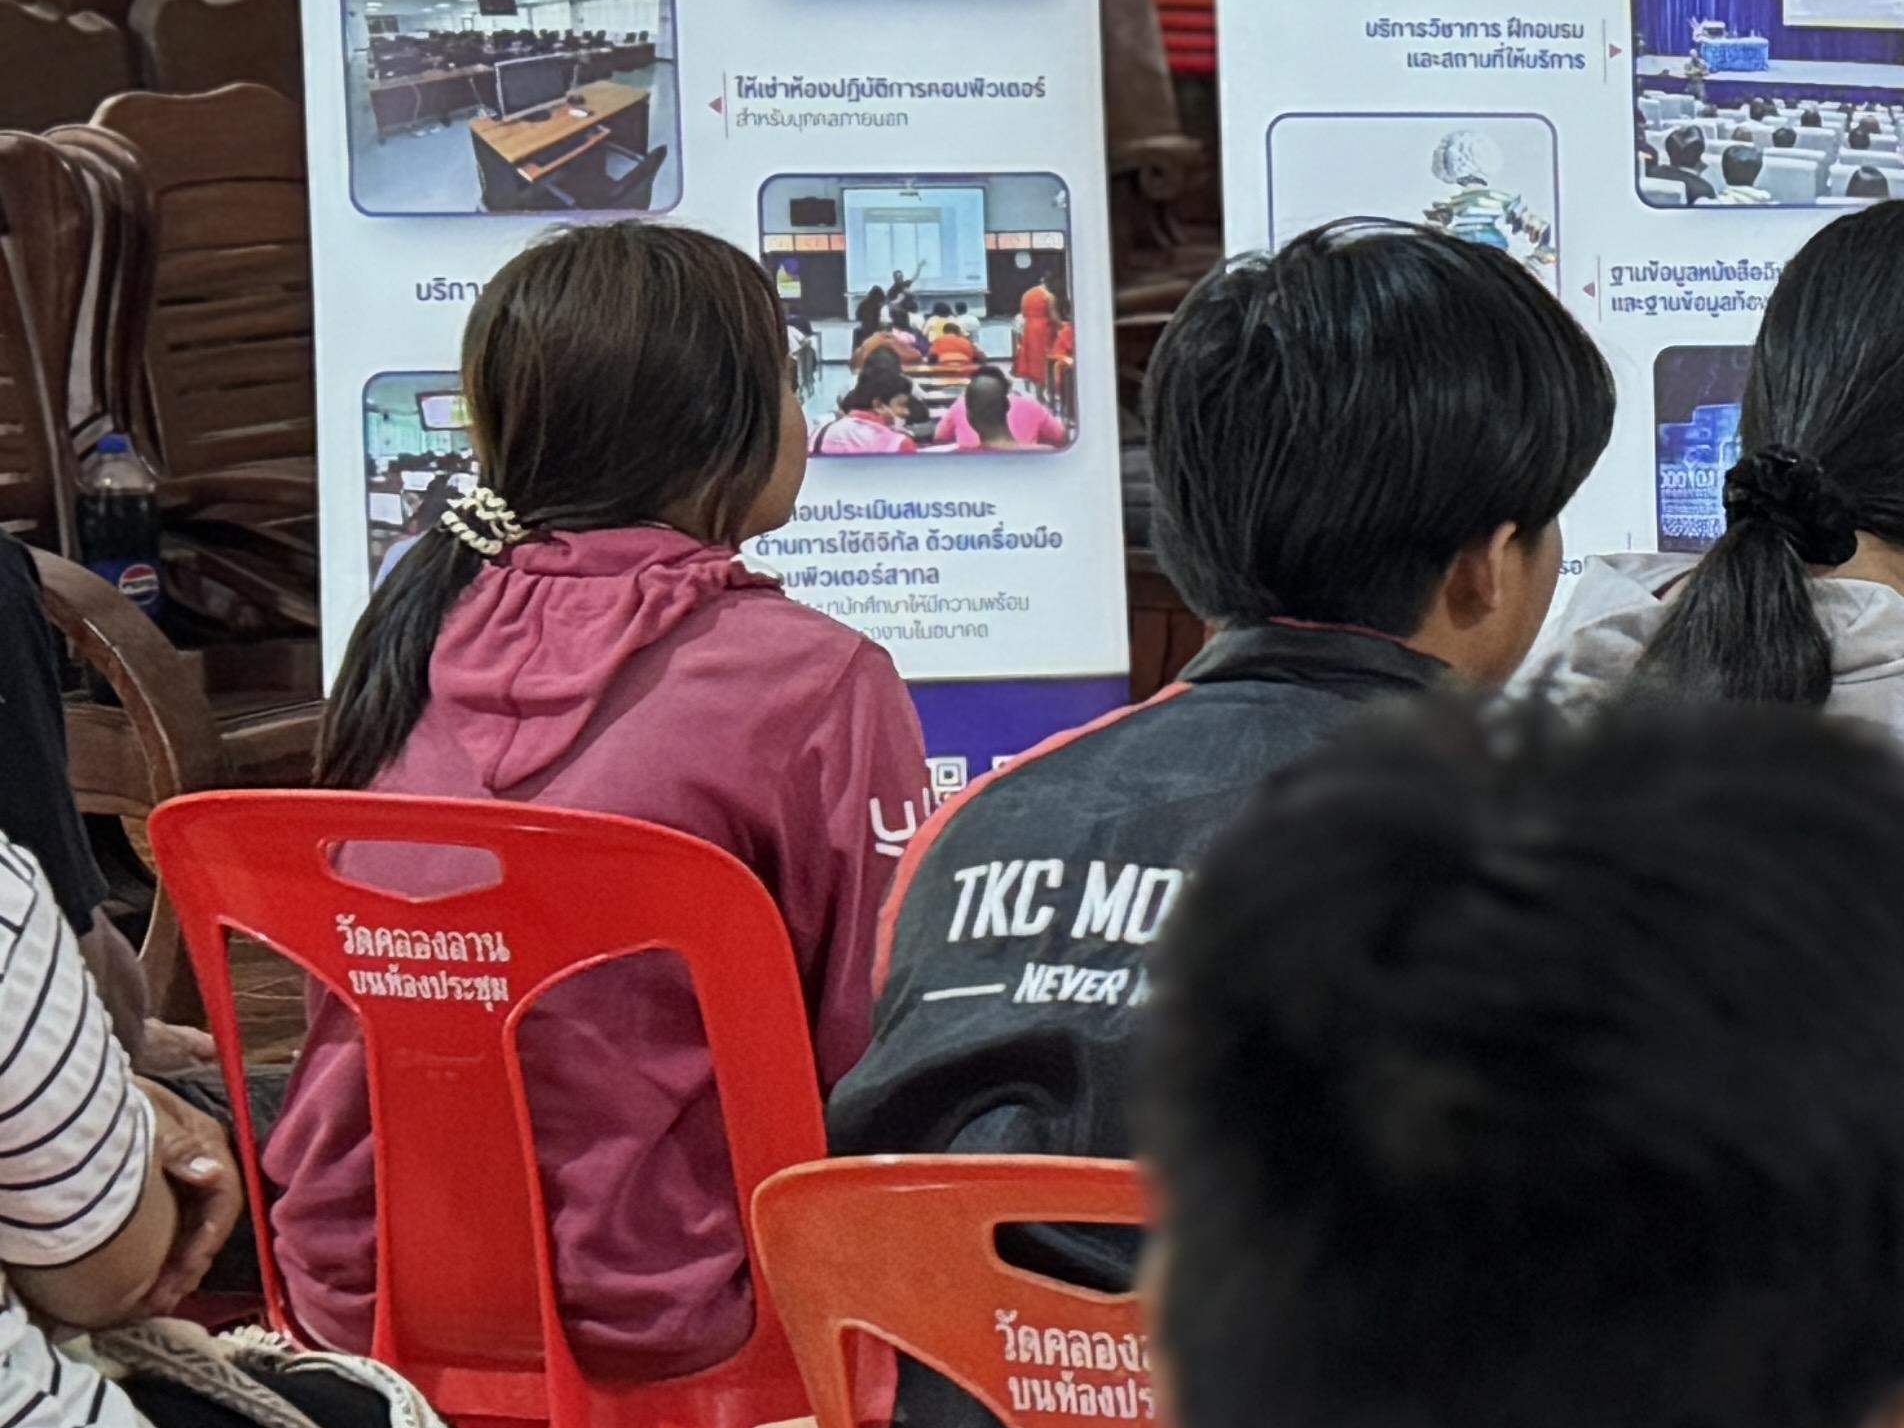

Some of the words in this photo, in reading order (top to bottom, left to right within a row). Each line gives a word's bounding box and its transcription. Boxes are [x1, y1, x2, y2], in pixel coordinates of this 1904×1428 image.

[1365, 18, 1502, 40] บริการวิชาการ
[1506, 17, 1585, 40] ฝึกอบรม
[1406, 42, 1586, 70] และสถานที่ให้บริการ
[416, 277, 487, 302] บริกา
[792, 499, 997, 522] อบประเมินสมรรถนะ
[926, 521, 1064, 551] ด้วยเครื่องมือ
[946, 859, 1064, 943] TKC
[1070, 860, 1186, 945] MO
[335, 913, 511, 963] วัดคลองลาน
[348, 963, 510, 1012] บนห้องประชุม
[1011, 962, 1129, 1005] NEVER
[1008, 1370, 1155, 1420] บนห้องปร
